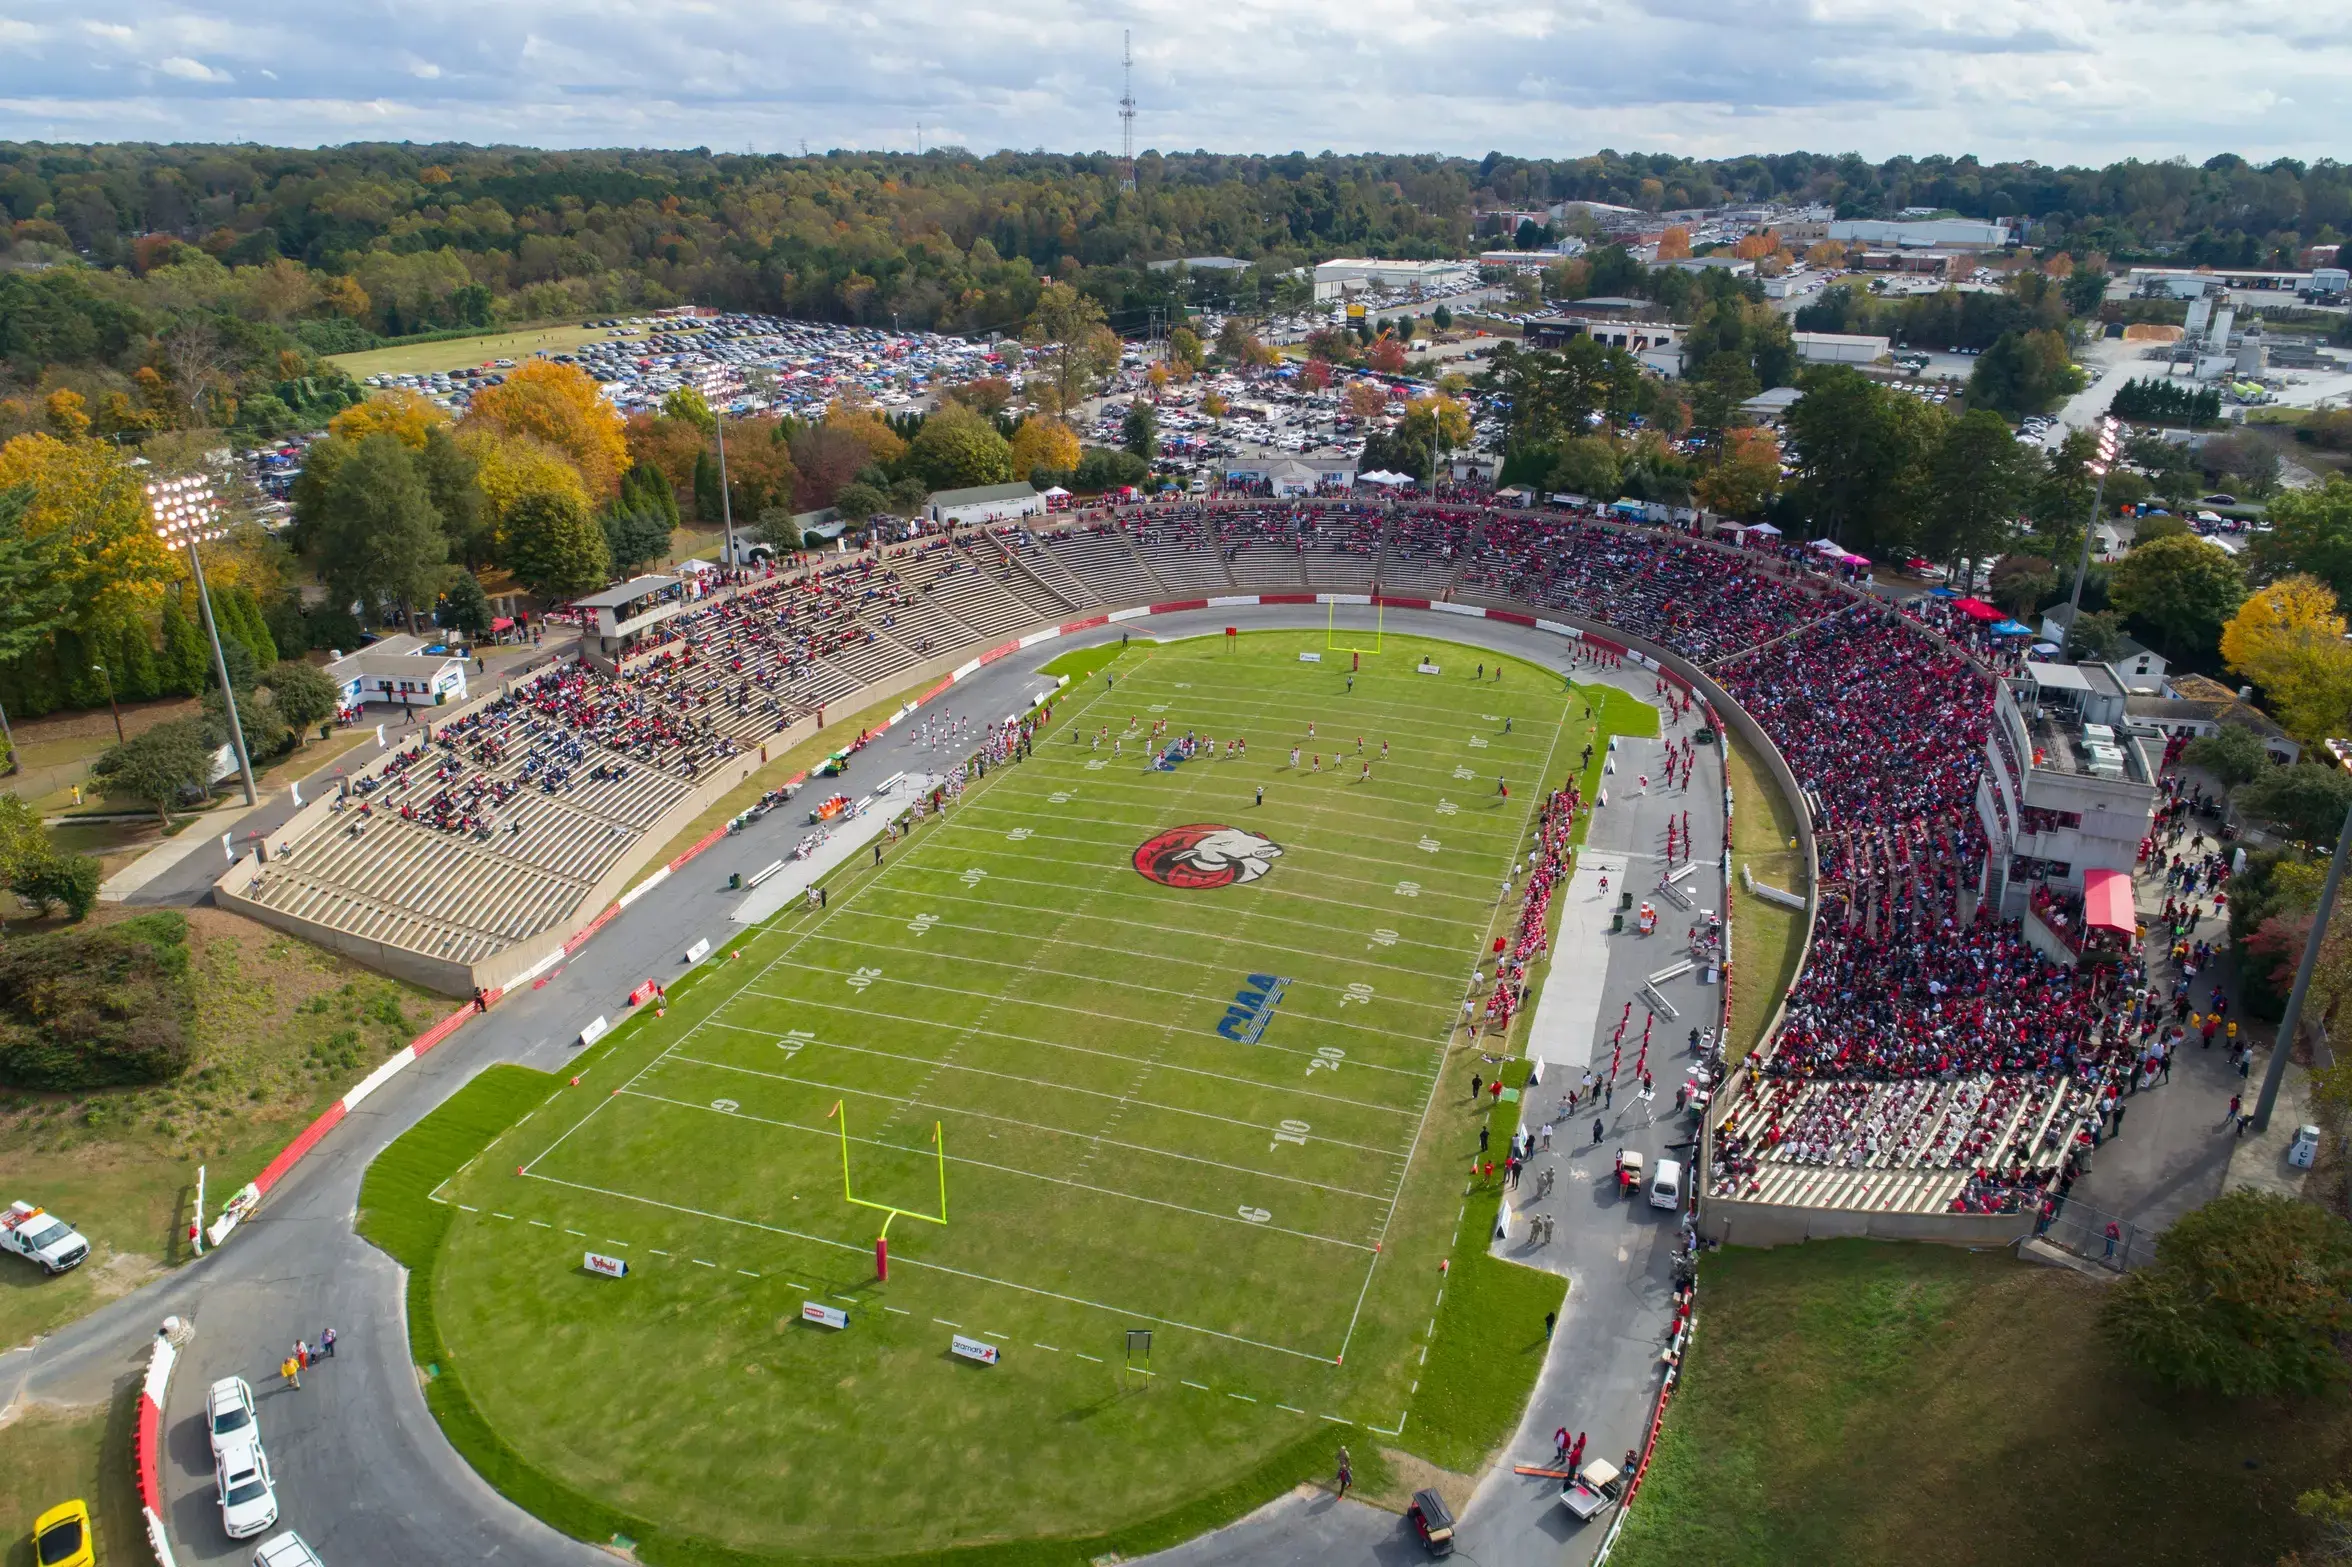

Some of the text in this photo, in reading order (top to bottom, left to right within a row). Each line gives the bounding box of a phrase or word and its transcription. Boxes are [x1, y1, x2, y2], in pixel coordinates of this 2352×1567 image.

[1468, 738, 1489, 748] 10
[1452, 768, 1476, 780] 20
[1047, 791, 1072, 803] 40
[1435, 802, 1459, 815] 30
[1006, 828, 1034, 840] 50
[1417, 839, 1441, 853] 40
[959, 867, 987, 882] 40
[1394, 881, 1421, 897] 50
[907, 913, 939, 931] 30
[1371, 928, 1399, 946] 40
[846, 967, 882, 986] 20
[1343, 983, 1374, 1004] 30
[776, 1029, 815, 1050] 10
[1310, 1047, 1345, 1071] 20
[1275, 1120, 1311, 1145] 10
[2297, 1144, 2309, 1166] ICE
[953, 1341, 984, 1355] aramark
